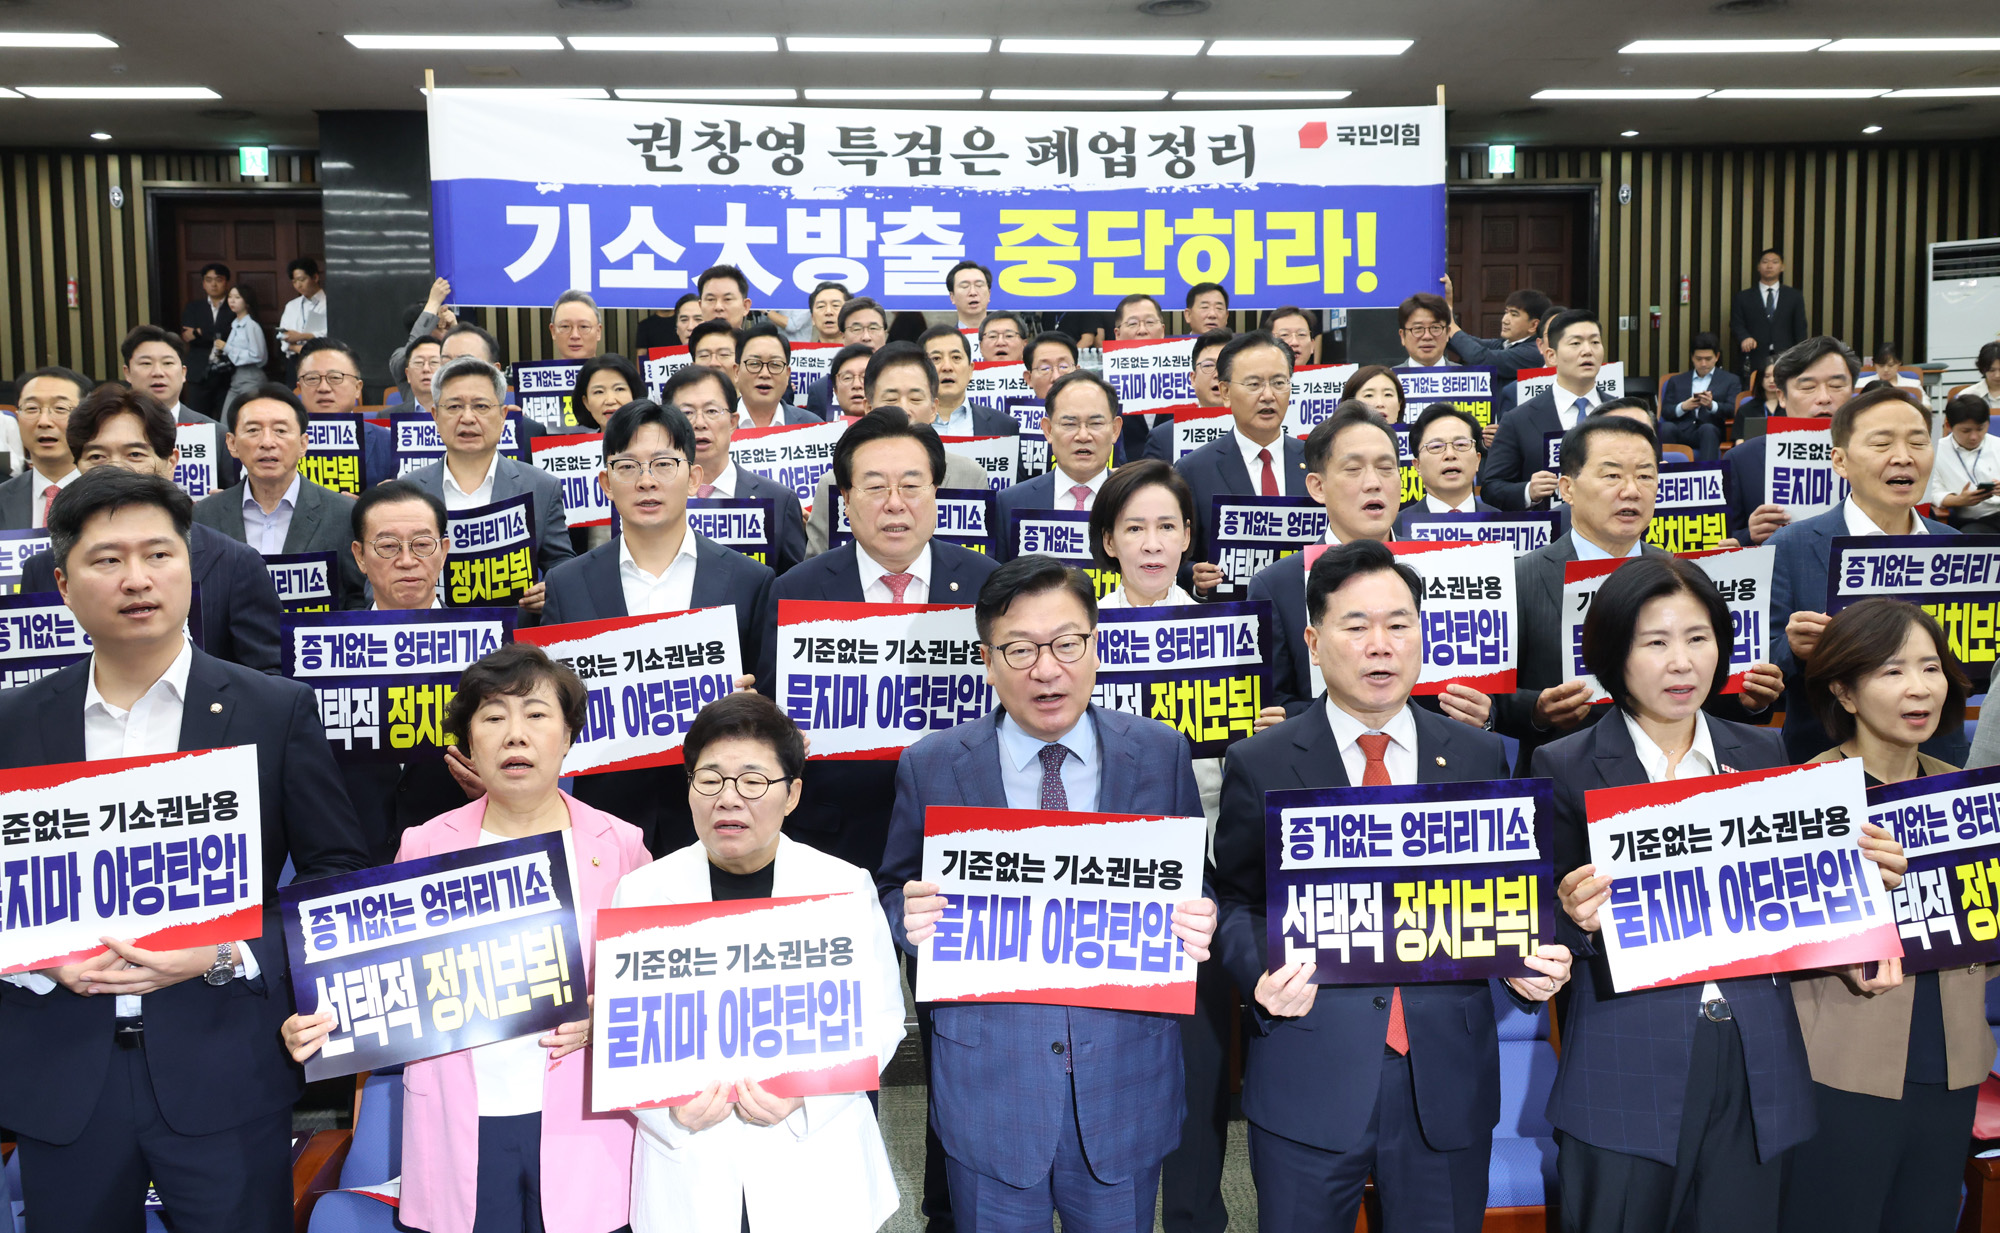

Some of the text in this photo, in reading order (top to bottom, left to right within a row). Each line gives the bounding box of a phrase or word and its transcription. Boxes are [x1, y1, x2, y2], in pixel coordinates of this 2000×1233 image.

[626, 117, 1256, 179] 권창영 특검은 폐업정리
[1336, 123, 1421, 147] 국민의힘
[994, 207, 1379, 297] 중단하라!
[522, 370, 563, 388] 증거없는
[1110, 356, 1193, 369] 기준없는 기소권남
[967, 379, 996, 391] 준없는
[1401, 375, 1488, 394] 증거없는 엉터리기소
[306, 425, 354, 445] 터리기소
[1013, 409, 1048, 430] 증거없
[542, 455, 592, 472] 기준없는
[1020, 440, 1048, 476] 택적
[1772, 466, 1834, 506] 묻지마
[453, 511, 525, 549] 엉터리기소
[936, 504, 983, 530] 리기소
[1224, 511, 1330, 537] 증거없는 엉터리
[1024, 525, 1084, 553] 증거없는
[270, 567, 325, 595] 리기소
[450, 547, 534, 604] 정치보복!
[1846, 554, 1924, 588] 증거없는
[301, 628, 498, 670] 증거없는 엉터리기소
[622, 640, 726, 673] 기소권남용
[793, 637, 878, 664] 기준없는
[1155, 622, 1255, 663] 엉터리기소
[314, 687, 380, 751] 택적
[786, 673, 869, 731] 묻지마
[1, 790, 239, 846] 준없는 기소권남용
[1289, 807, 1531, 861] 증거없는 엉터리기소
[1610, 805, 1851, 863] 기준없는 기소권남용
[0, 832, 249, 932] 지마 야당탄압!
[942, 849, 1184, 890] 기준없는 기소권남용
[308, 862, 551, 952] 증거없는 엉터리기소
[1609, 866, 1713, 950] 묻지마
[1718, 847, 1876, 935] 야당탄압!
[1890, 866, 1962, 951] 택적
[932, 893, 1032, 963] 묻지마
[1282, 875, 1540, 964] 선택적 정치보복!
[614, 936, 855, 982] 기준없는 기소권남용
[314, 923, 574, 1058] 선택적 정치보복!
[607, 979, 864, 1069] 묻지마 야당탄압!
